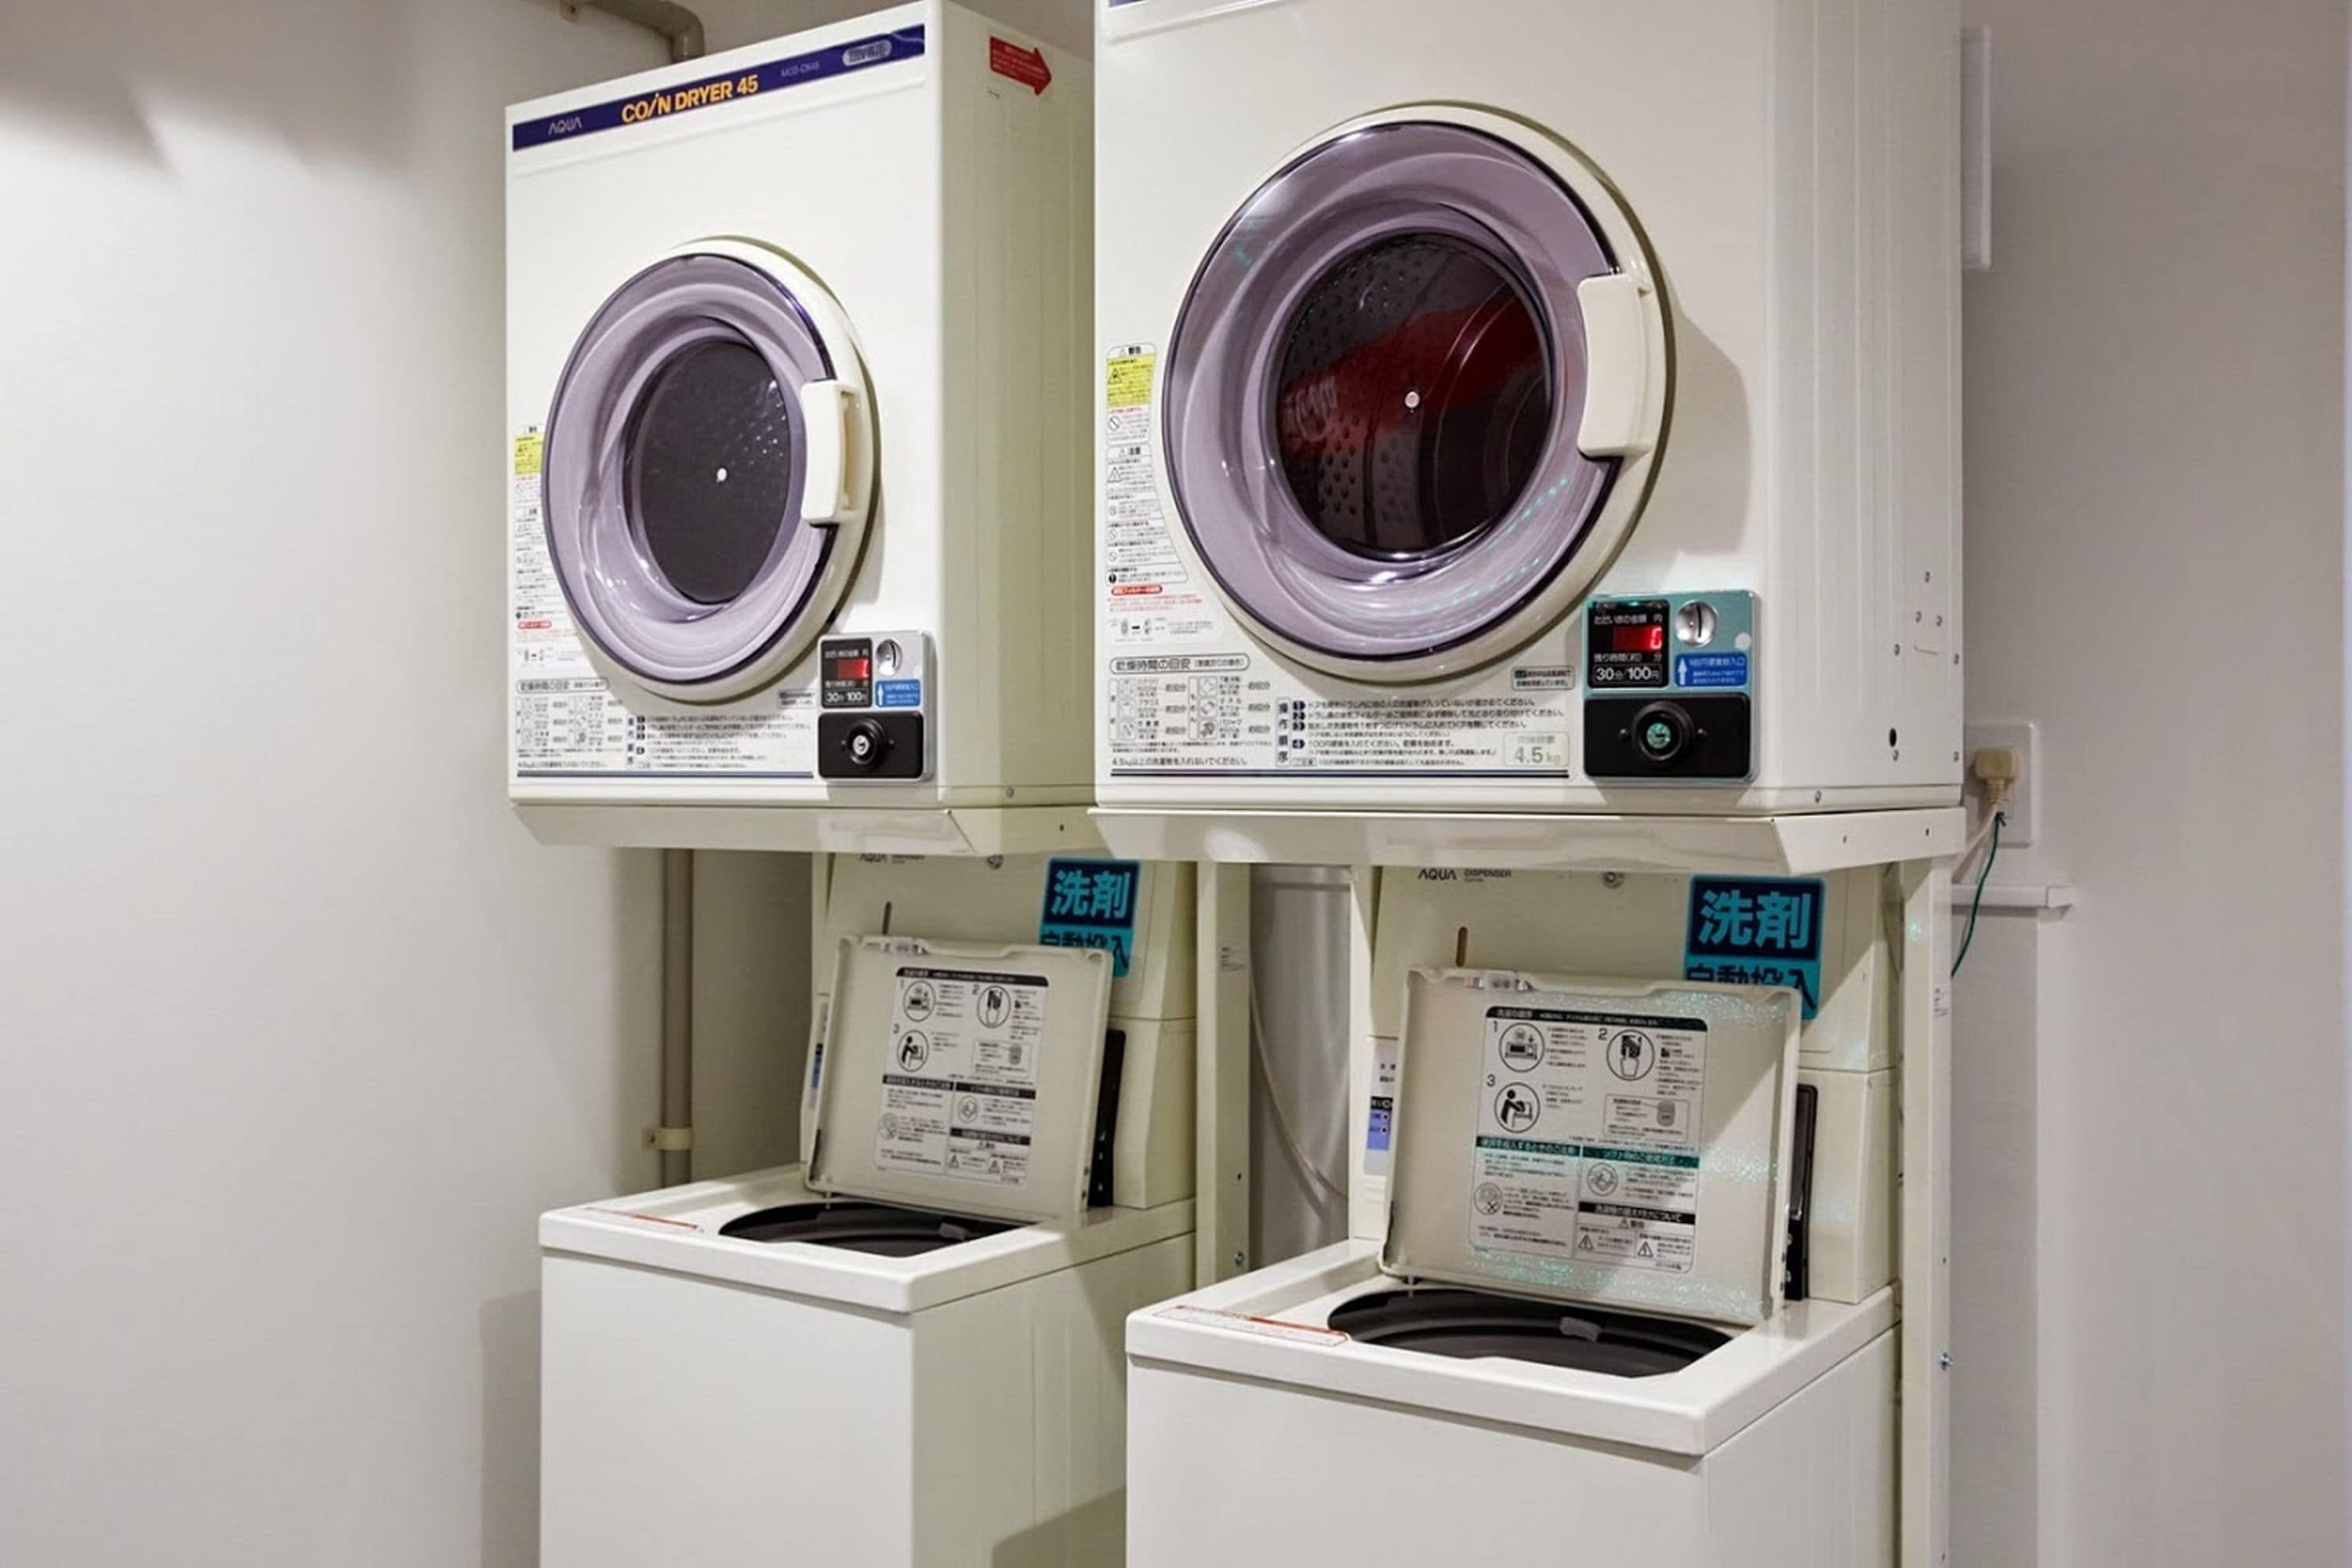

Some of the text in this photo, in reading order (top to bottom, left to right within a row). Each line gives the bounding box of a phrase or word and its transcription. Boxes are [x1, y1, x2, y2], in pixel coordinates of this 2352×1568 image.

[675, 81, 732, 111] DRYER
[737, 74, 759, 95] 45
[548, 116, 582, 136] AQUA
[1515, 746, 1543, 763] 4.5
[1417, 868, 1457, 880] AQUA
[1051, 869, 1131, 920] 洗剤
[1699, 890, 1811, 949] 洗剤
[1599, 1028, 1608, 1040] 2
[1486, 1074, 1496, 1087] 3
